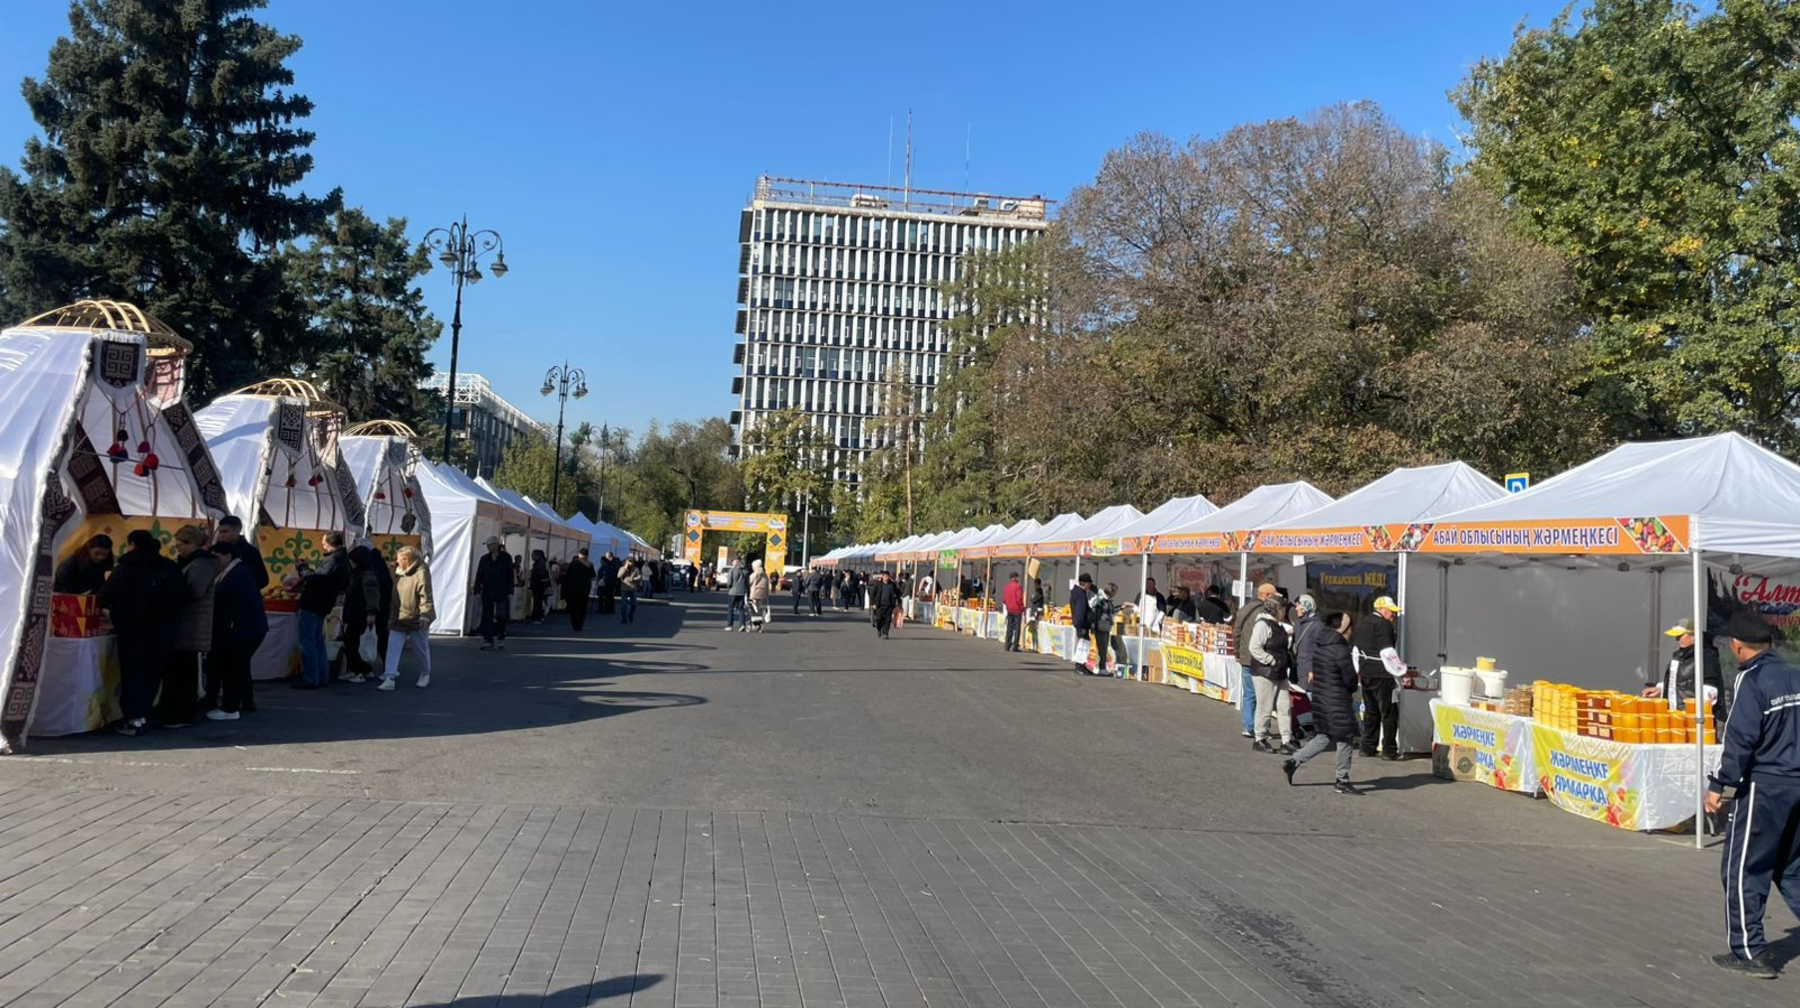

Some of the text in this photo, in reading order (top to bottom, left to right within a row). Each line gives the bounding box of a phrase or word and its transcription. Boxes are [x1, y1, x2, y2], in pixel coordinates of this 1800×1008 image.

[1434, 527, 1618, 549] АБАЙ ОБЛЫСЫНЫҢ ЖӘРМЕҢКЕСІ
[1550, 750, 1608, 779] ЖӘРМЕҢКЕ
[1554, 775, 1607, 805] ЯРМАРКА
